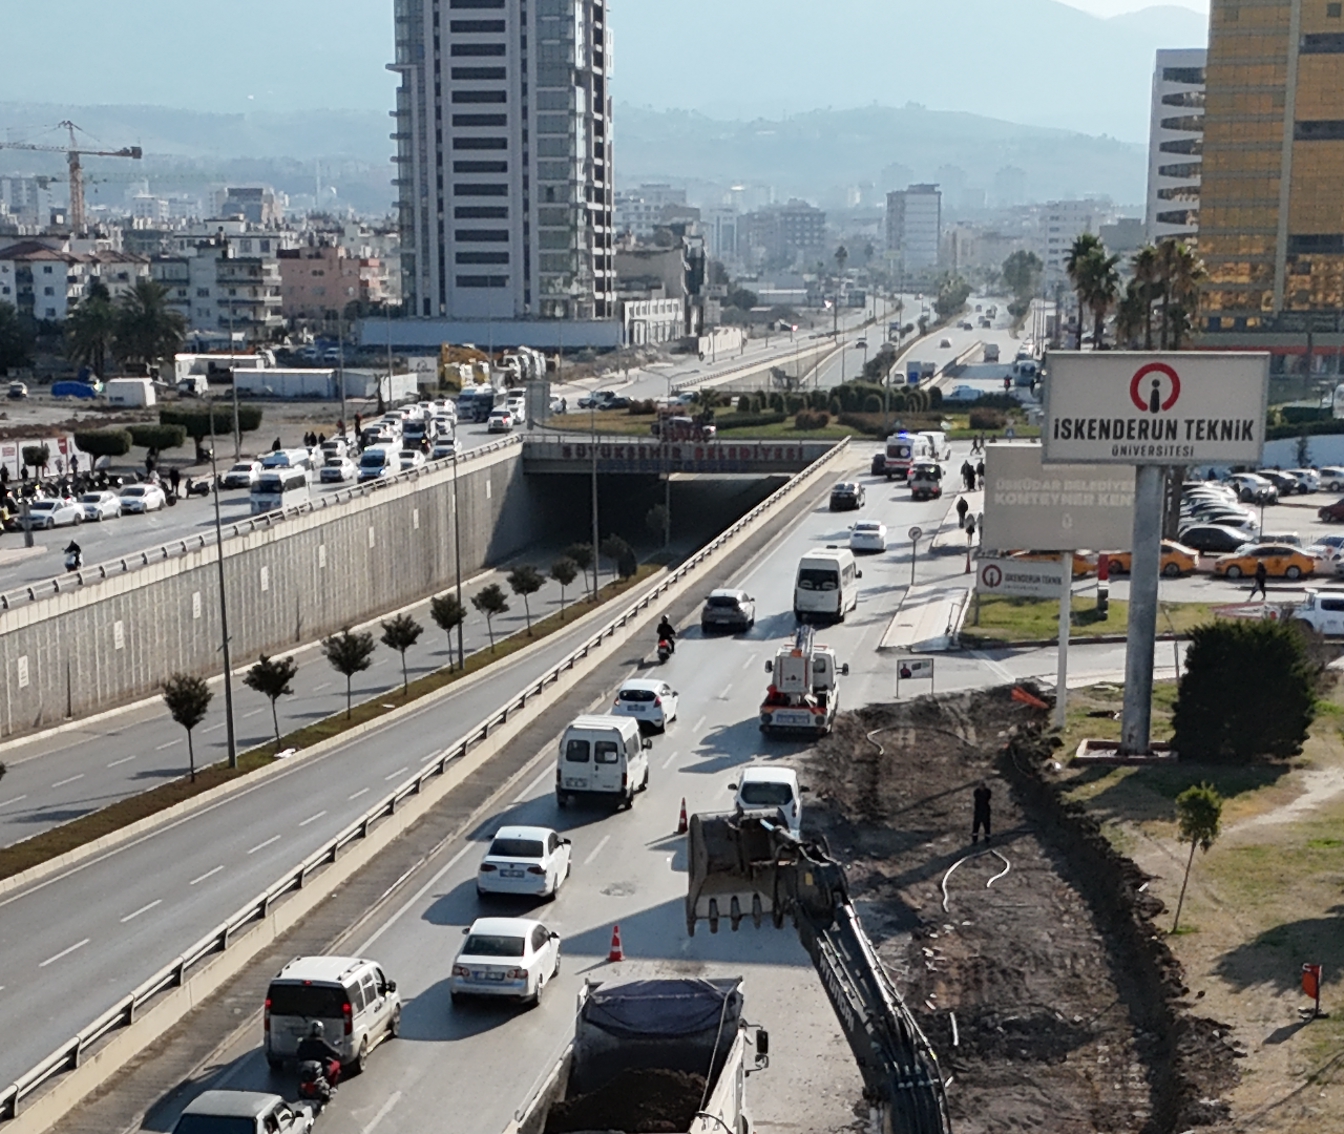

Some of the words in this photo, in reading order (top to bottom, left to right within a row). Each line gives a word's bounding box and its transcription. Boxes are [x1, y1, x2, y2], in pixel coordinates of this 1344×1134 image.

[1054, 418, 1177, 440] İSKENDERUN
[1184, 419, 1254, 441] TEKNİK
[1111, 445, 1194, 457] ÜNİVERSİTESİ
